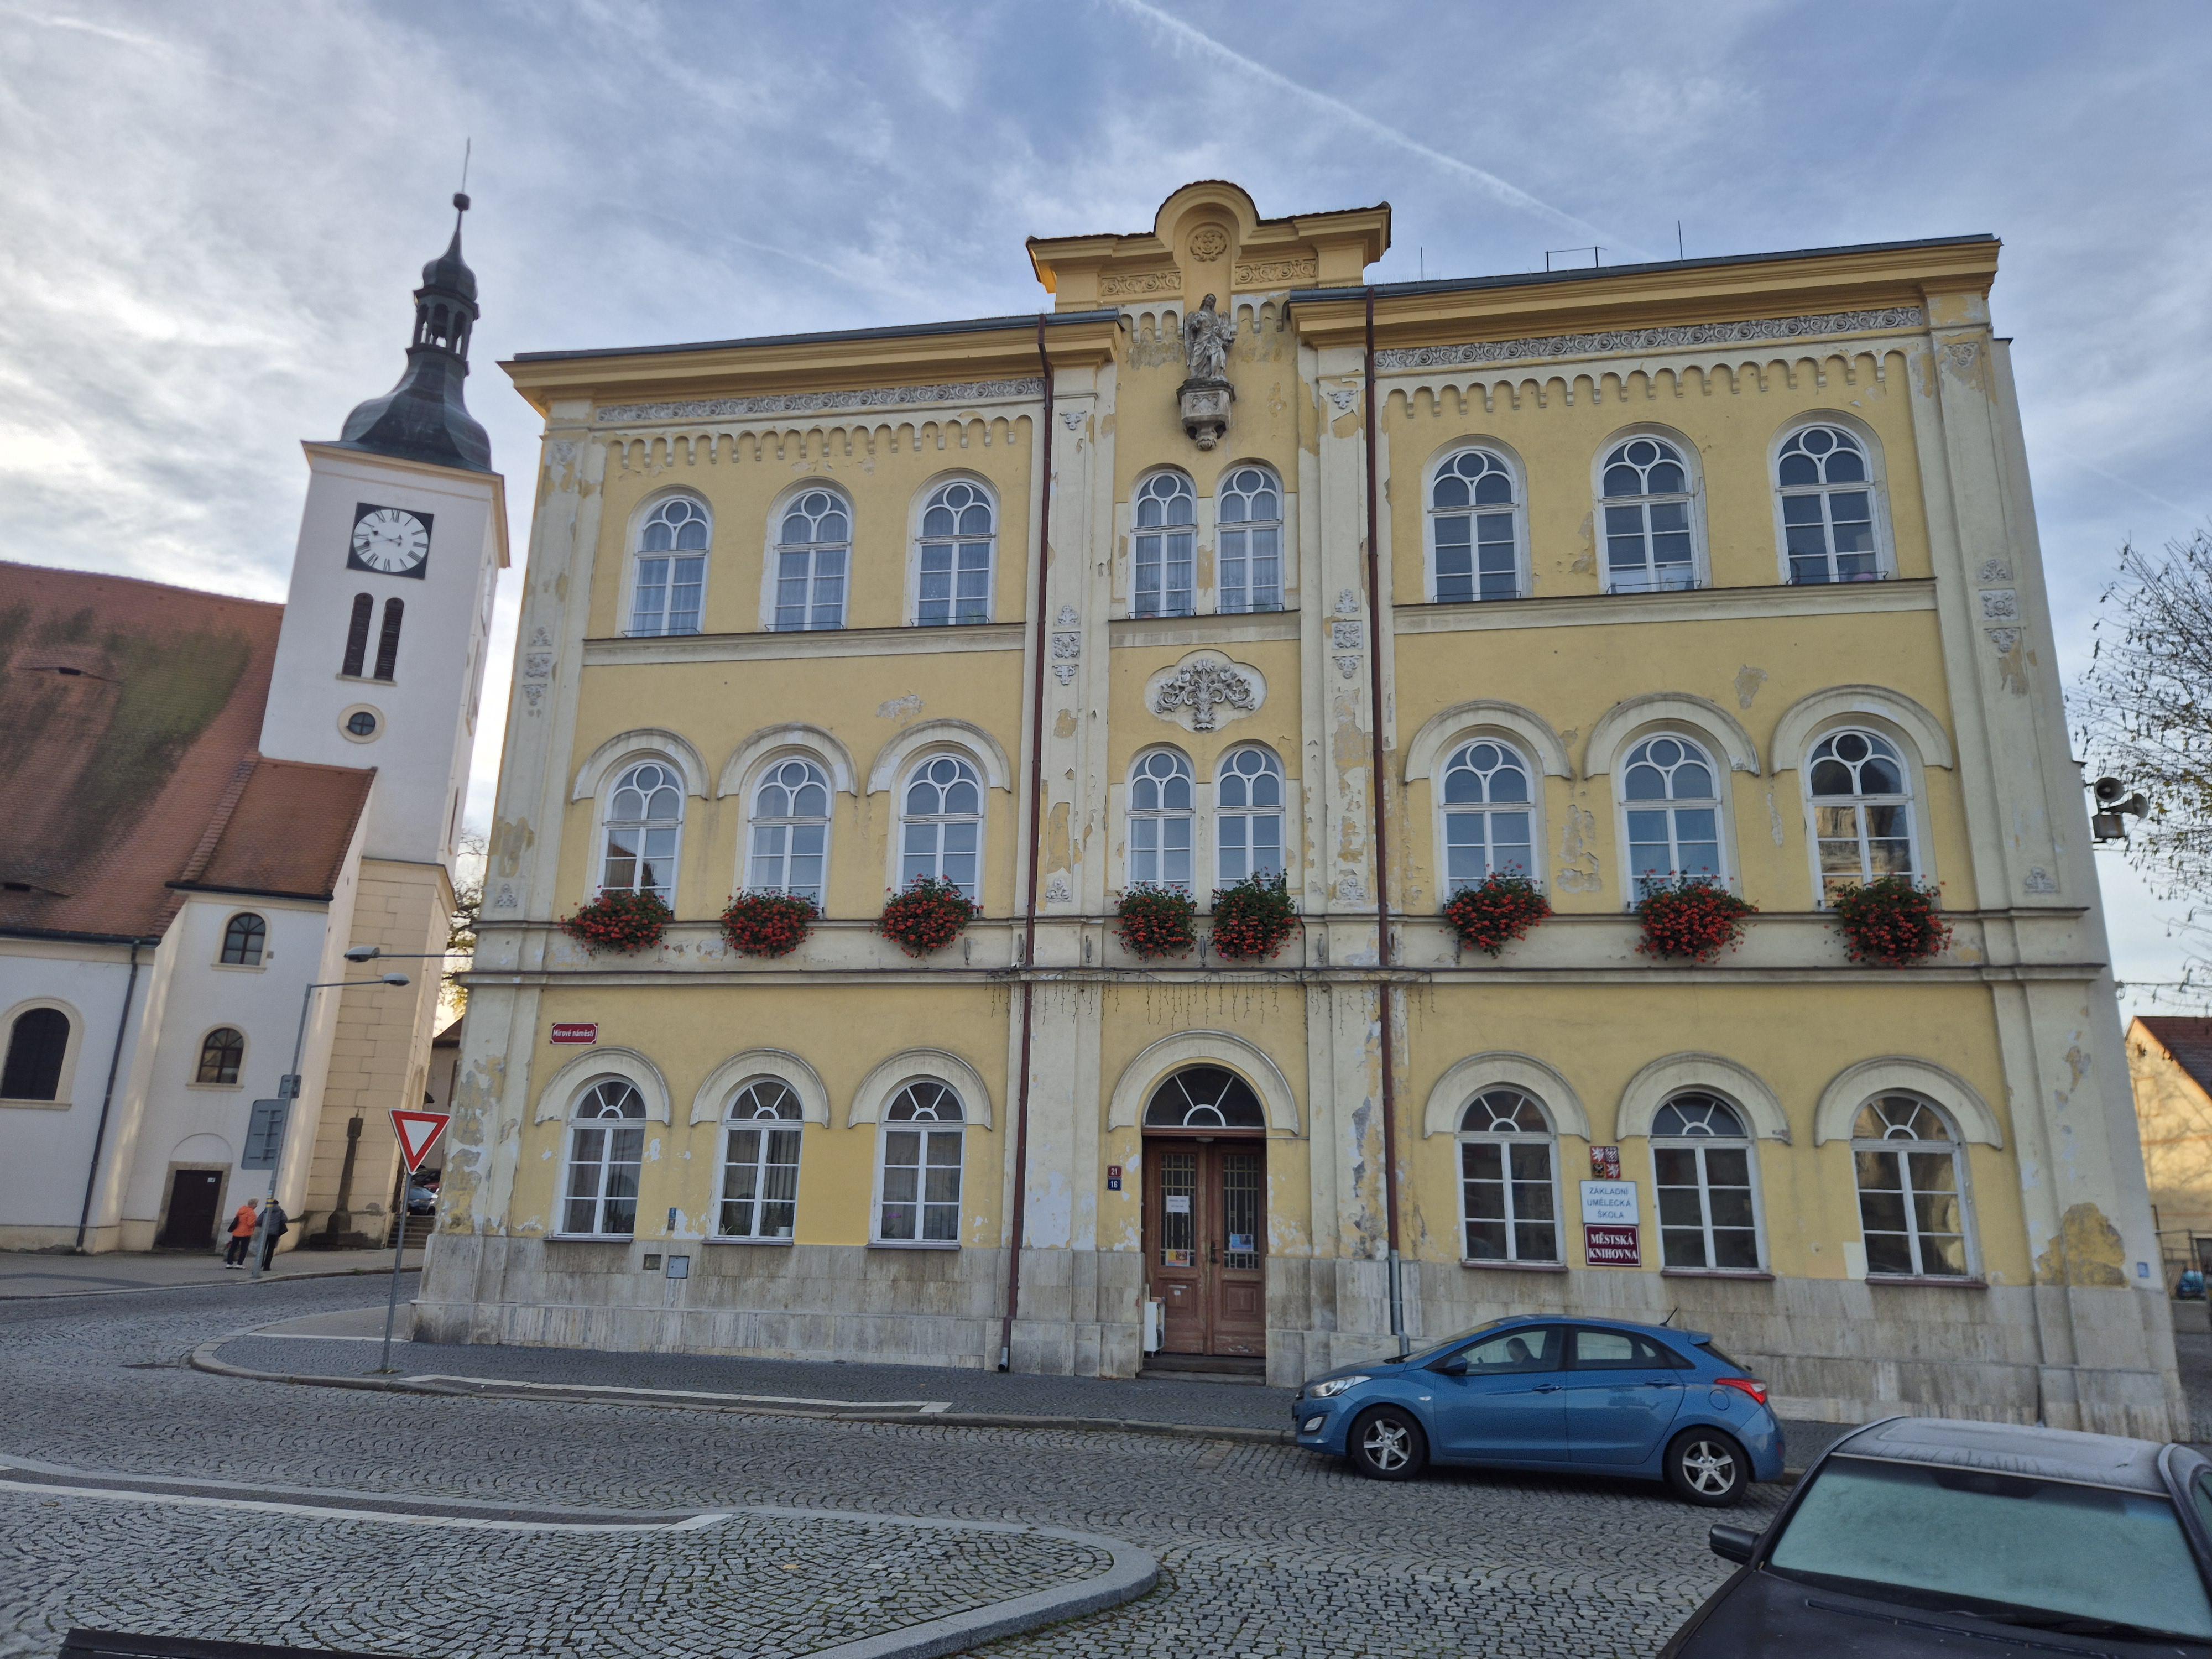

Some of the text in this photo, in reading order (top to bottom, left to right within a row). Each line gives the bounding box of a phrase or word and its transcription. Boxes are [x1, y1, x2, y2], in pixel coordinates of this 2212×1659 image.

[1589, 1186, 1629, 1195] ZÁKLADNÍ
[1597, 1209, 1624, 1218] ŠKOLA
[1590, 1232, 1634, 1245] MĚSTSKÁ
[1588, 1247, 1639, 1260] KNIHOVNA
